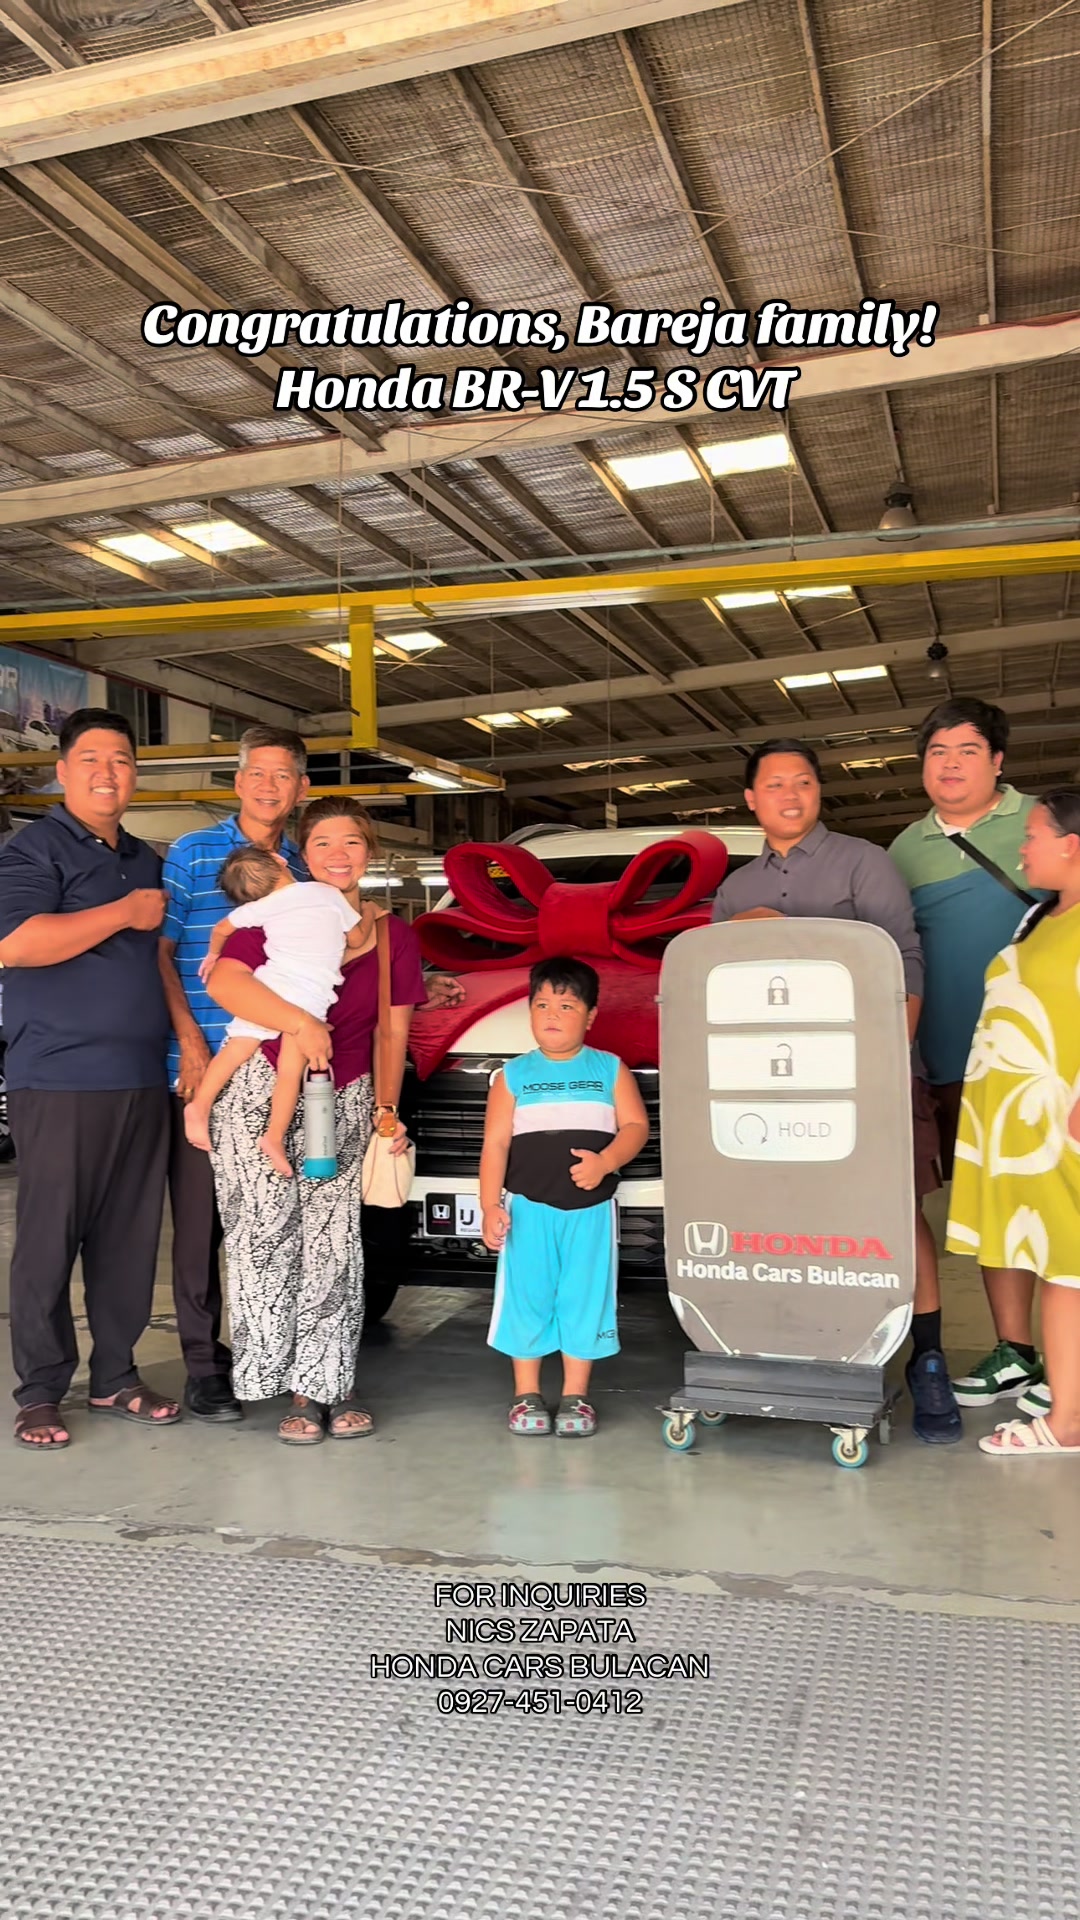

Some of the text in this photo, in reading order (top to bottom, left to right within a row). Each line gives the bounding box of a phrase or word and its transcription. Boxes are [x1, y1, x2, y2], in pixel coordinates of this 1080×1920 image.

[523, 1081, 603, 1091] MOOSE GEAR
[779, 1122, 832, 1137] HOLD
[730, 1231, 893, 1260] HONDA
[677, 1258, 900, 1289] Honda Cars Bulacan
